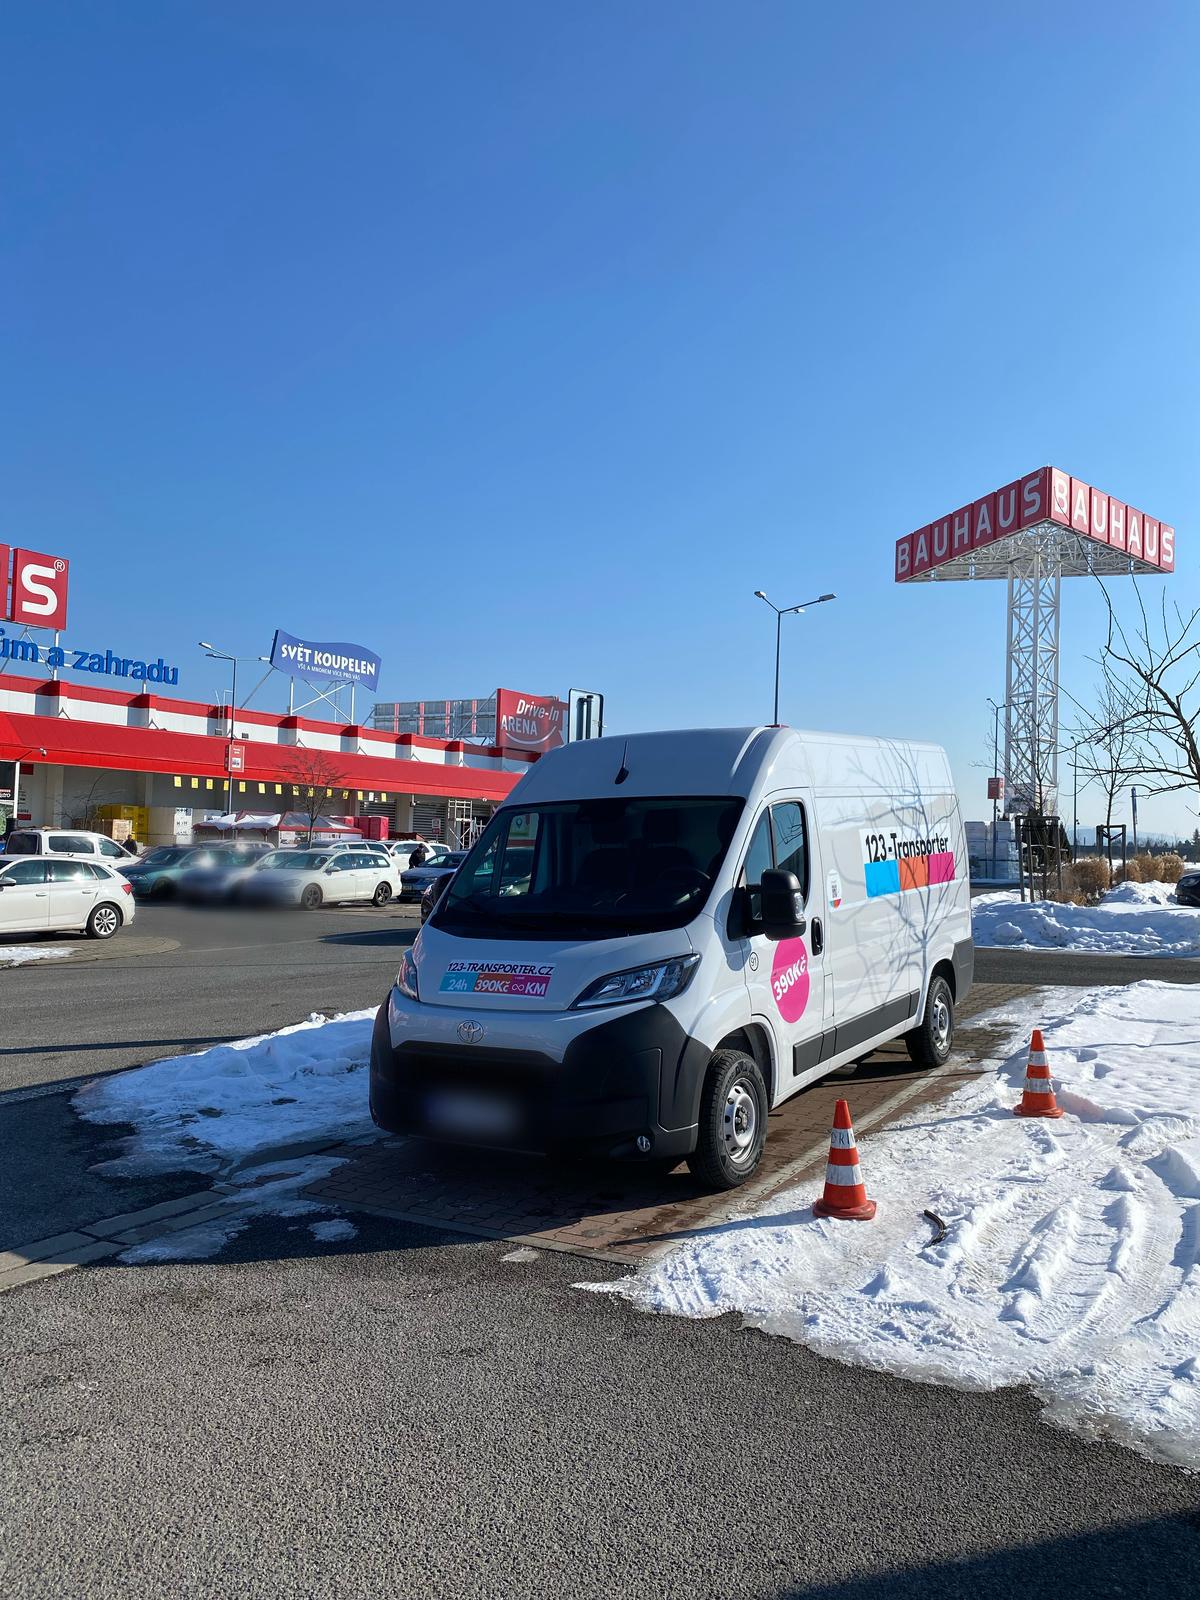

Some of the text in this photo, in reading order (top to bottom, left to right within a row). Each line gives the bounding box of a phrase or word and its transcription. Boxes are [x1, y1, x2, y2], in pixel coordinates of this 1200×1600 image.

[1054, 478, 1174, 564] BAUHAUS
[48, 646, 65, 667] a
[73, 650, 179, 685] zahradu
[281, 643, 376, 676] SVĚT KOUPELEN
[501, 714, 538, 736] ARENA
[516, 699, 560, 721] Drive-In
[865, 832, 949, 864] 123-Transporter
[447, 962, 555, 976] 123-TRANSPORTER.CZ
[773, 954, 806, 1001] 390Kč
[447, 979, 468, 991] 24h
[474, 979, 511, 992] 390Kč
